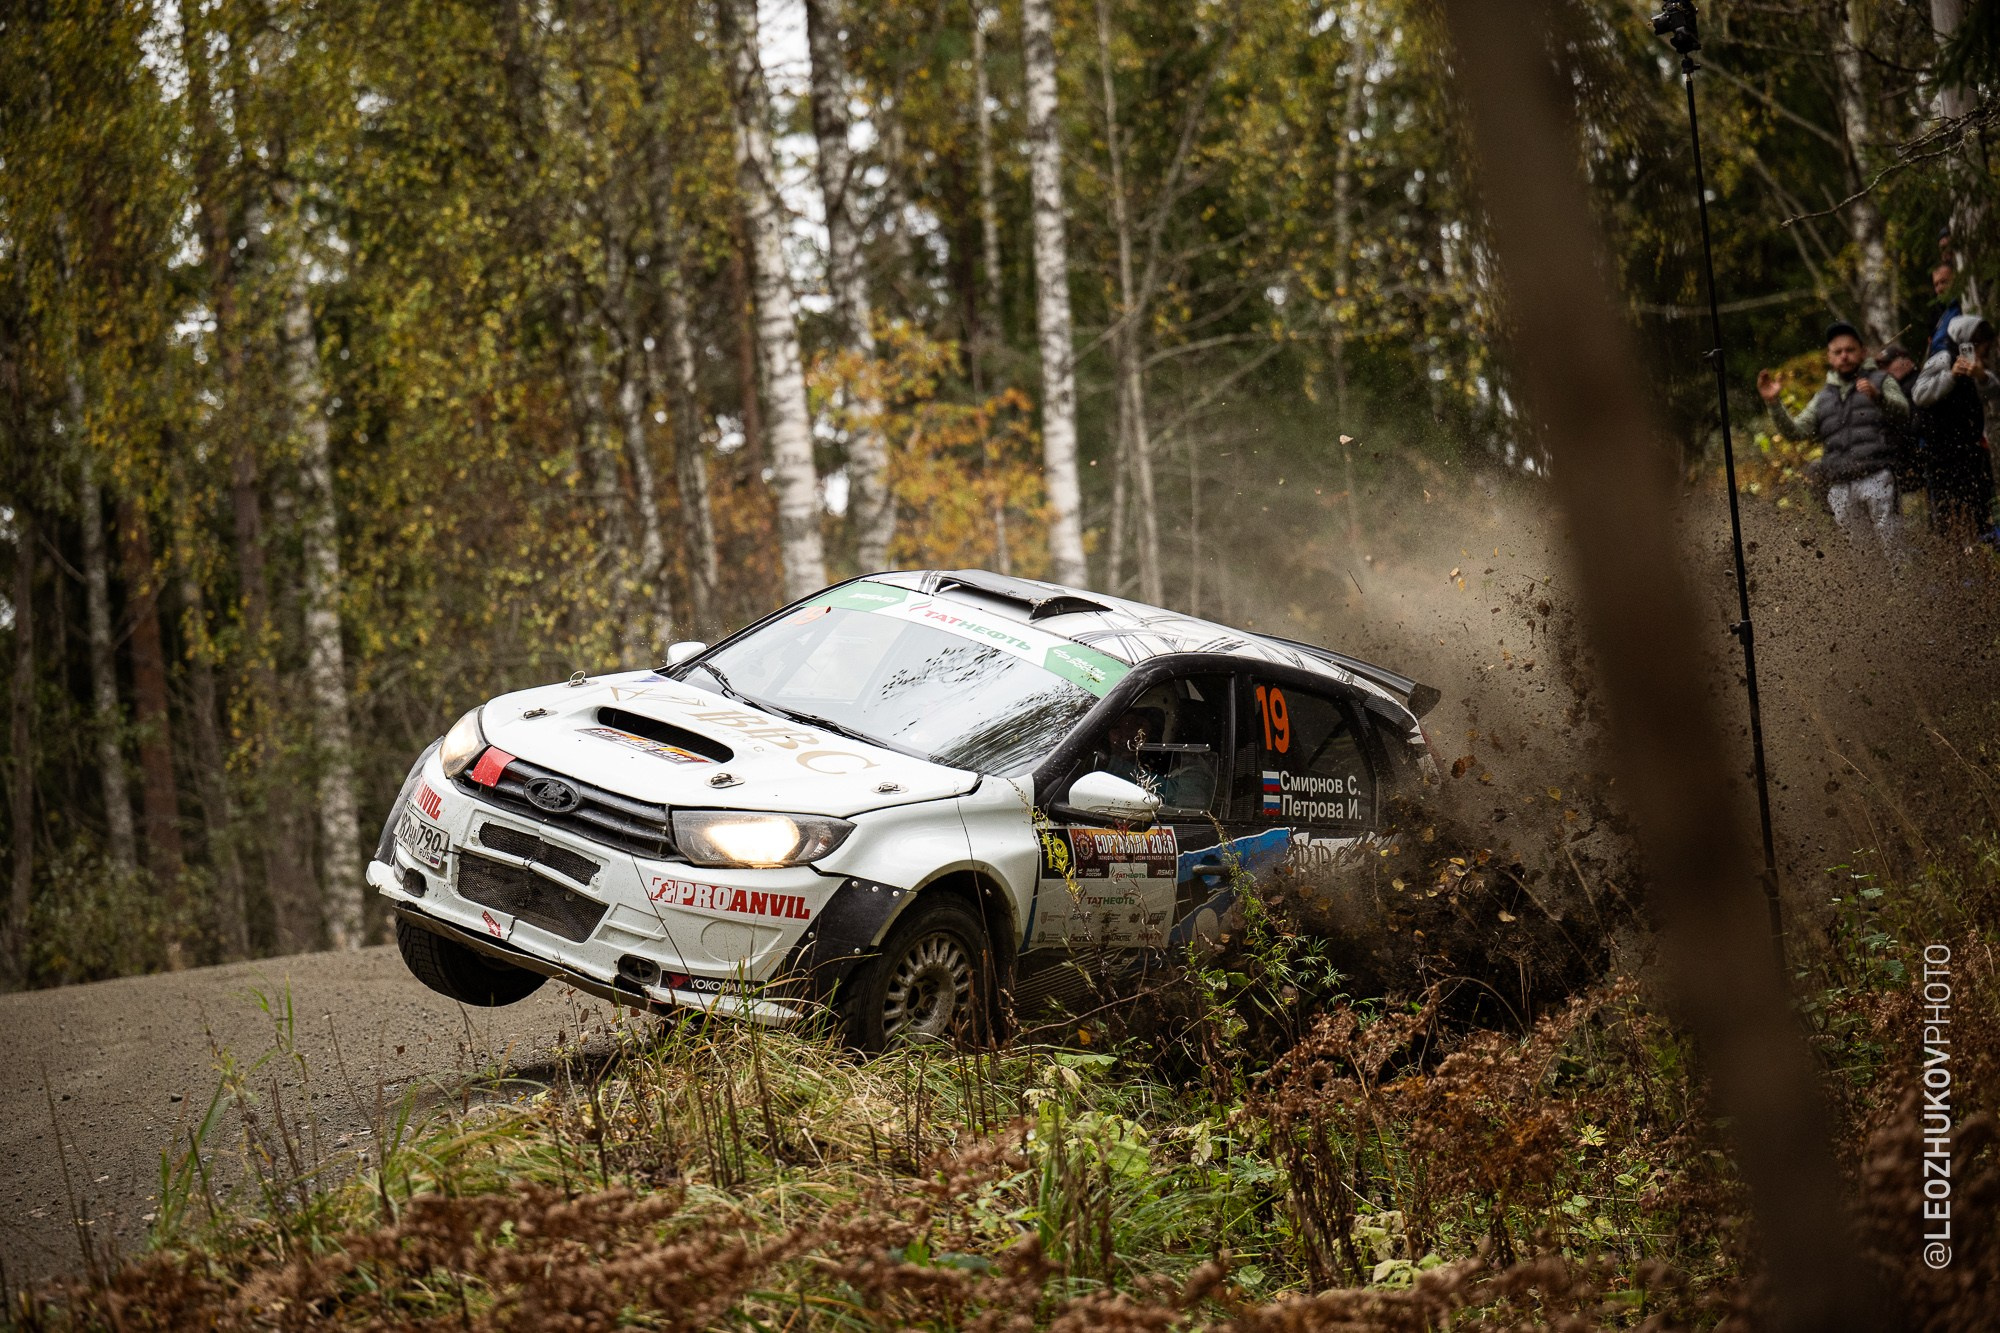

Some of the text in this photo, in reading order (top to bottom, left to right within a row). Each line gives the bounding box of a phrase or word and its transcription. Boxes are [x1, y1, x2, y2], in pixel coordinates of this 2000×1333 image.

[924, 610, 1032, 651] ТАТНЕФТЬ
[1256, 686, 1290, 753] 19
[1280, 771, 1361, 797] Смирнов С.
[1282, 794, 1362, 822] Петрова И.
[416, 824, 442, 853] 790
[419, 848, 431, 860] RUS
[675, 880, 811, 920] PROANVIL
[1087, 896, 1135, 905] ТАТНЕФТЬ
